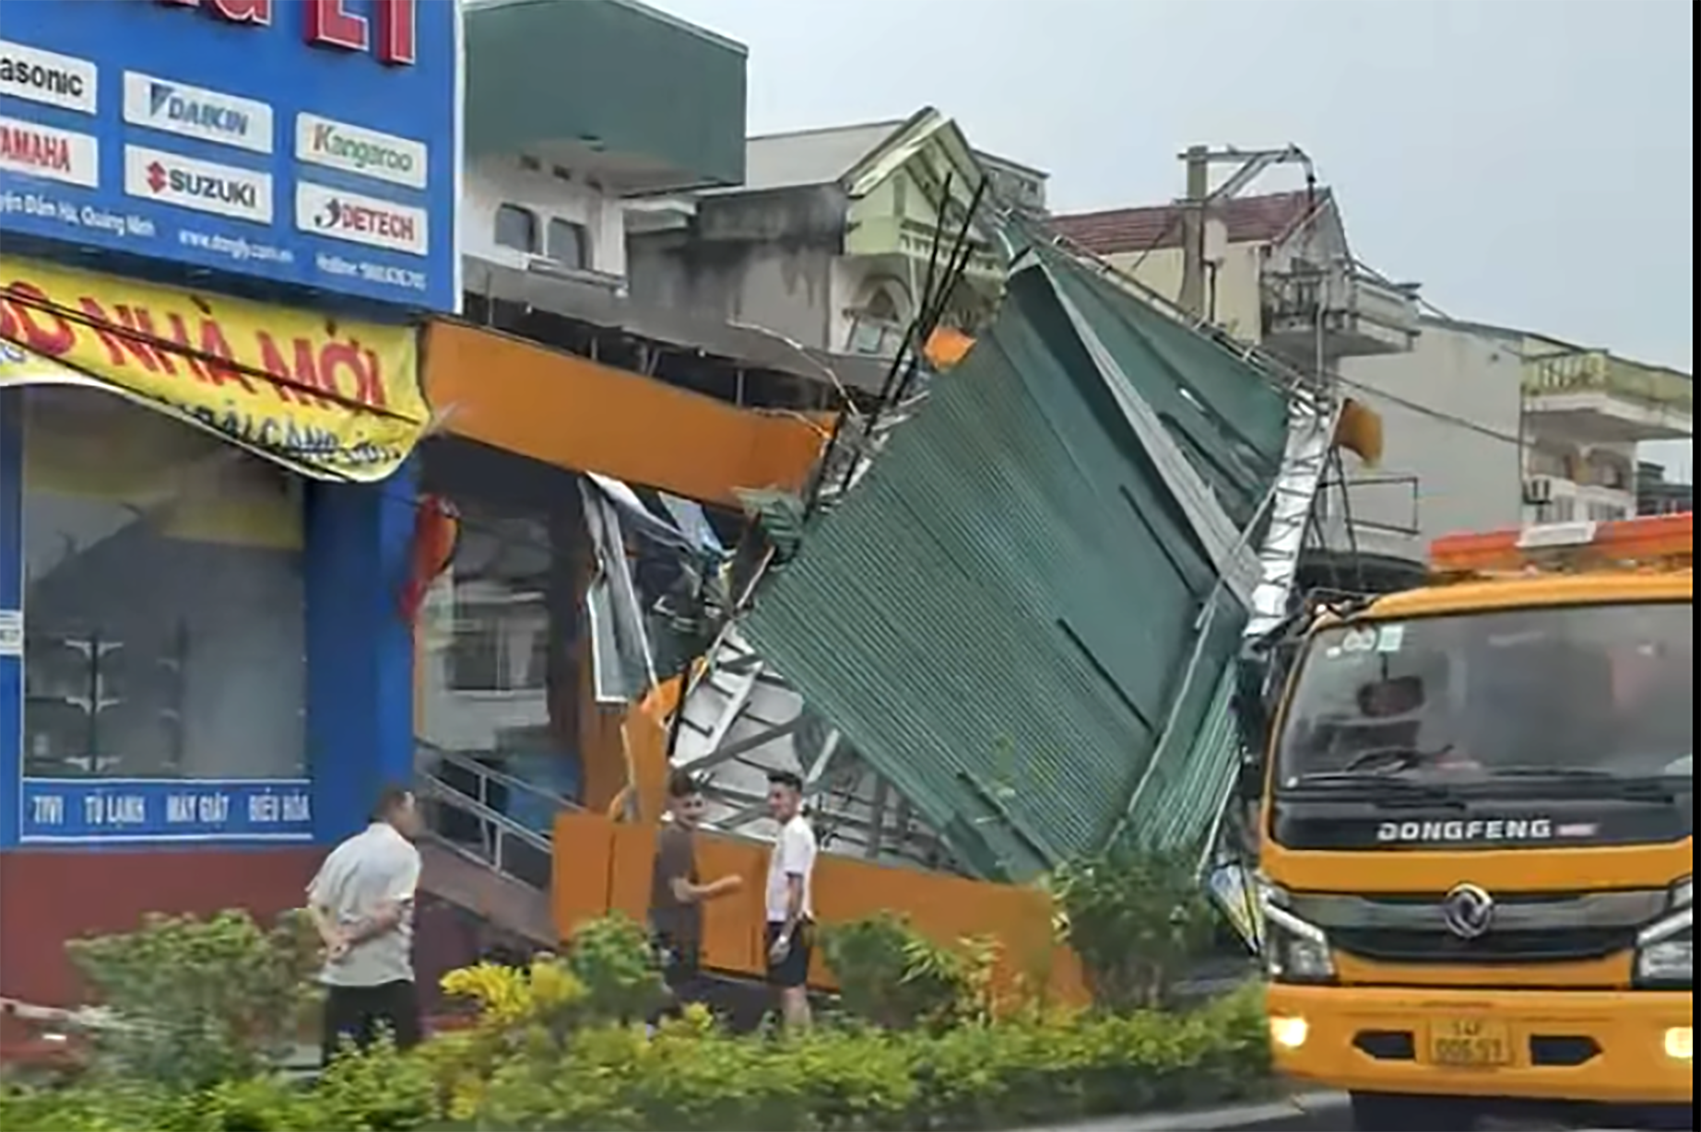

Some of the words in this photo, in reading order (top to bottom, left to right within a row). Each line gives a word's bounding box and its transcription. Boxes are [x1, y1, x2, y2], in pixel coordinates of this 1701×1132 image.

[168, 96, 249, 136] DAIKIN
[313, 122, 413, 172] Kangaroo
[168, 168, 256, 208] SUZUKI
[341, 203, 415, 241] DETECH
[1376, 819, 1551, 841] DONGFENG
